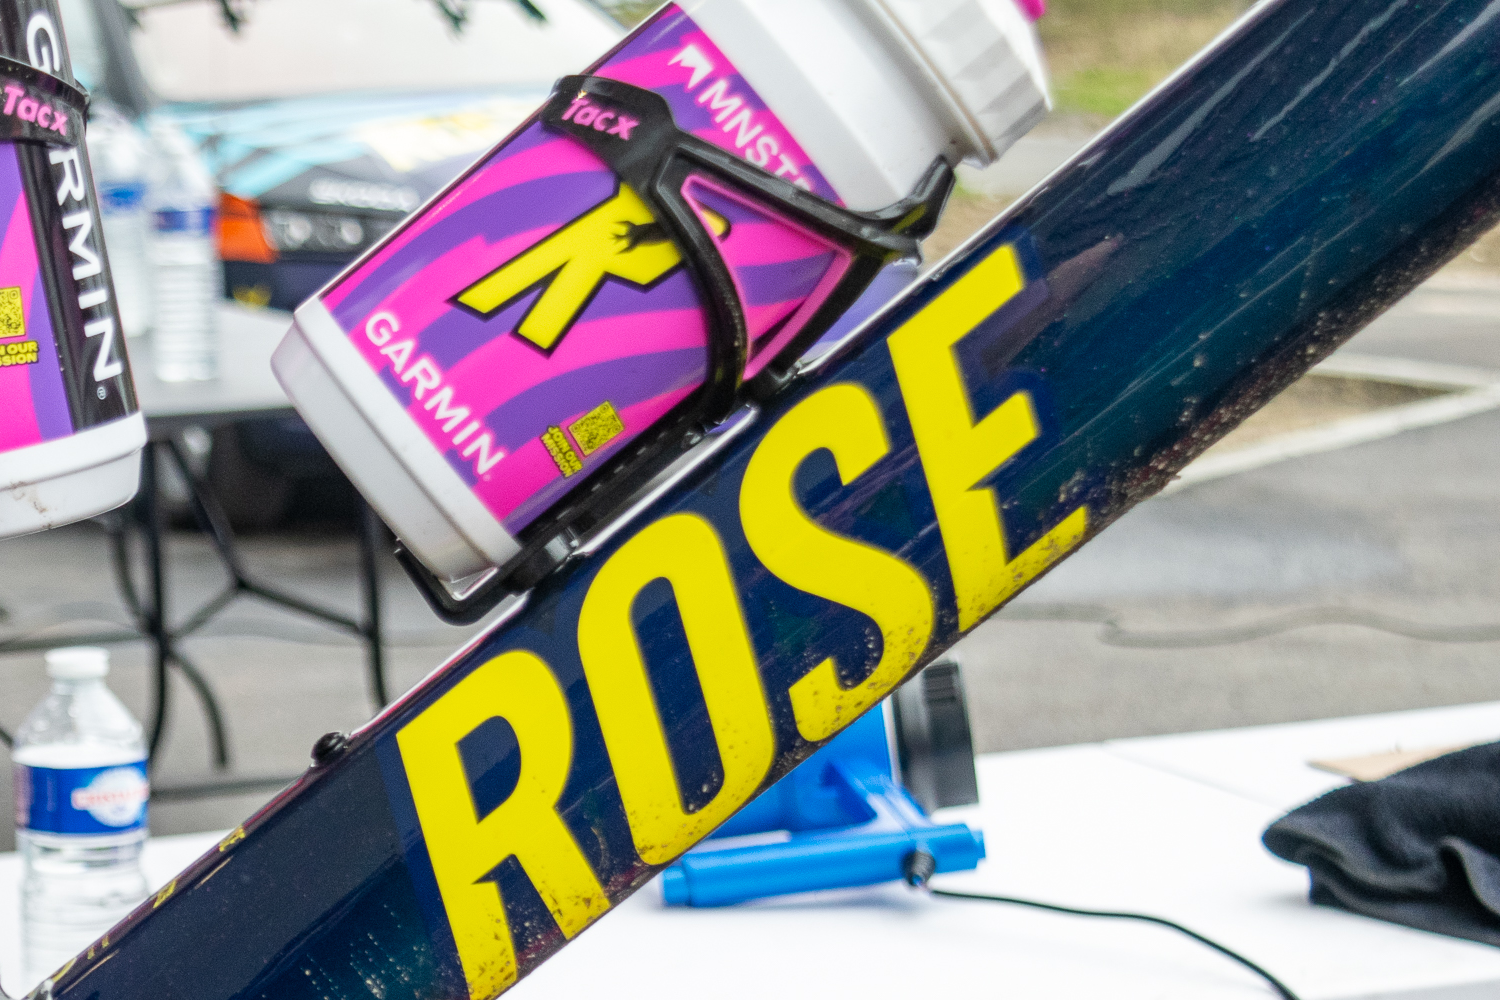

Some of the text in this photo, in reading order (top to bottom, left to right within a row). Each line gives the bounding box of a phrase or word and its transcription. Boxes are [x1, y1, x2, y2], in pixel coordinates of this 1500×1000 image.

[3, 85, 68, 136] Tacx
[561, 96, 640, 141] Tacx
[26, 13, 123, 382] GRMIN
[6, 340, 39, 355] OUR
[365, 312, 505, 475] GARMIN
[540, 432, 573, 478] MISSION
[547, 426, 583, 472] JOIN OUR
